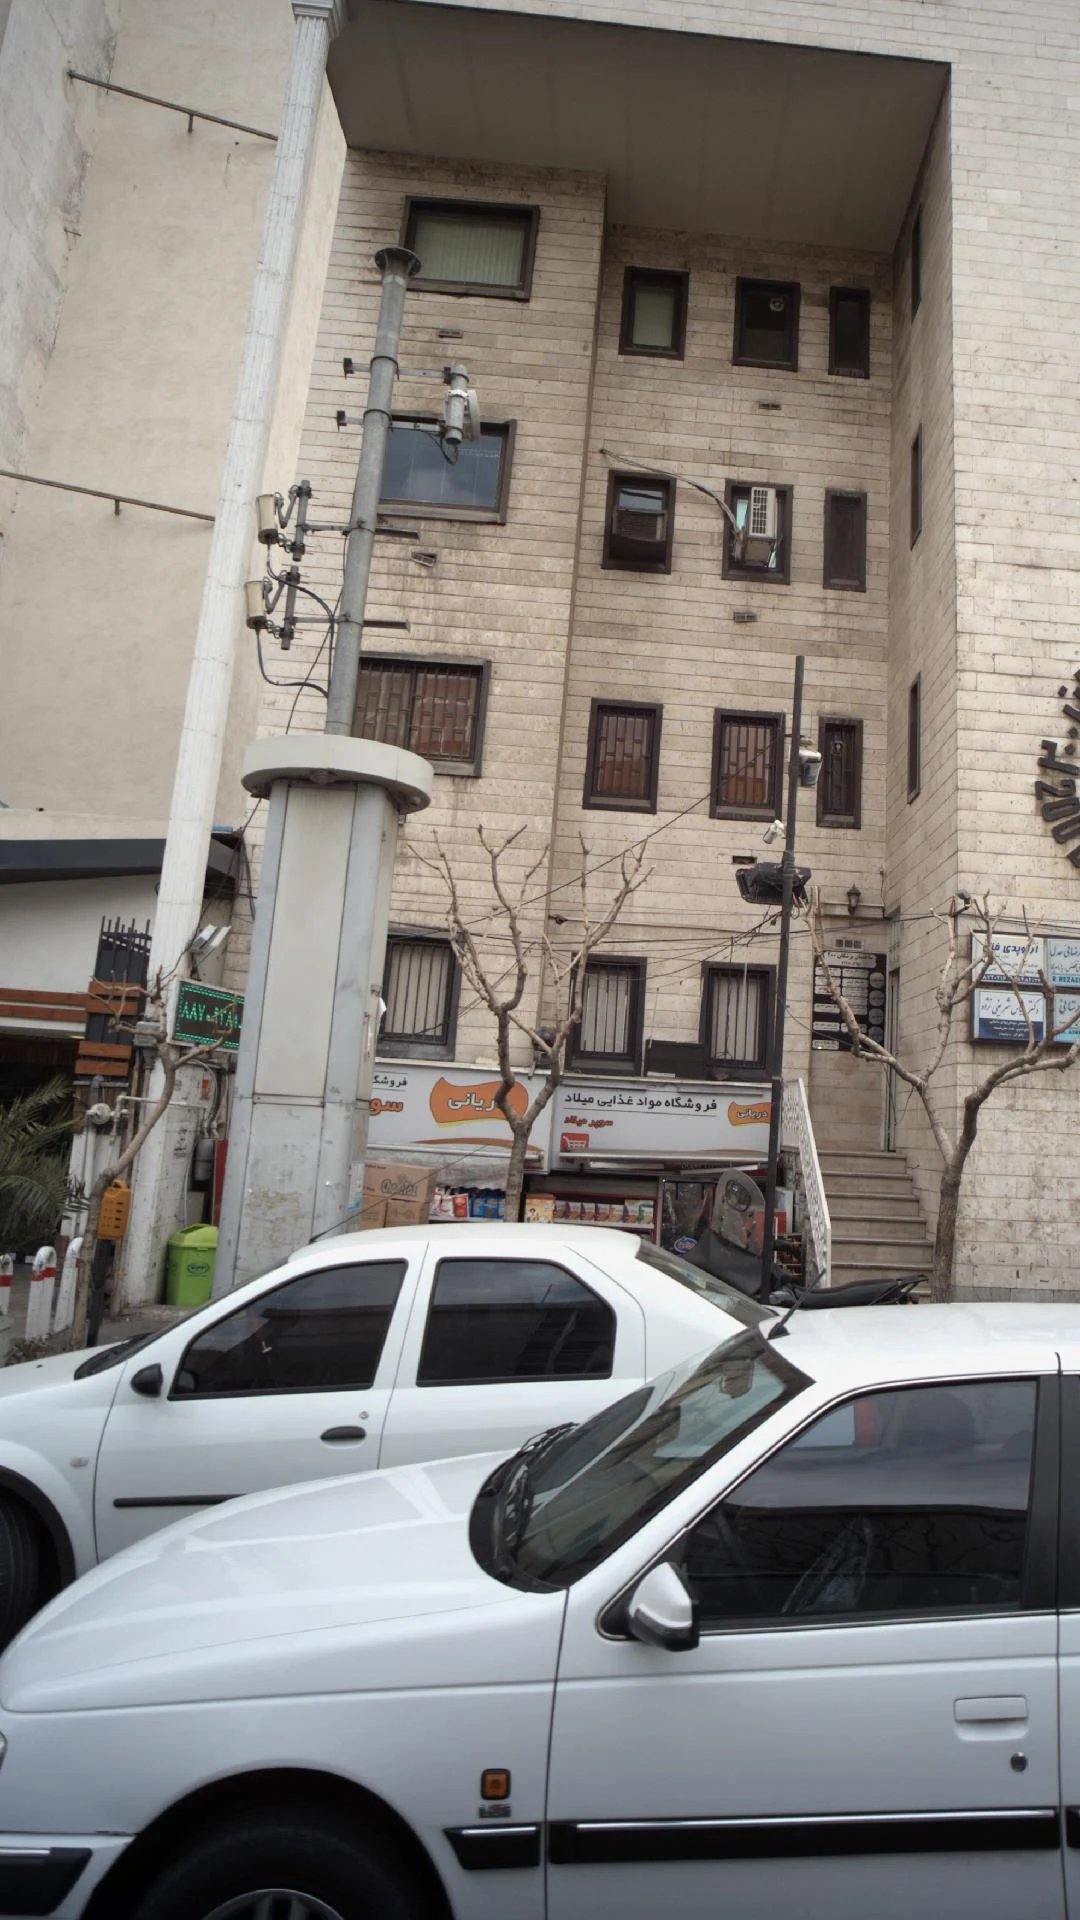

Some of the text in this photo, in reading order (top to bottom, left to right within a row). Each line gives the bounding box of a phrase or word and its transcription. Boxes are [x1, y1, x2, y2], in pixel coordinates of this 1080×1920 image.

[1003, 944, 1039, 957] اروپدی
[372, 1074, 408, 1088] فروشگ
[369, 1097, 404, 1117] سو
[447, 1092, 497, 1112] ریانی
[564, 1092, 717, 1112] فروشگاه مواد غذایی میلاد
